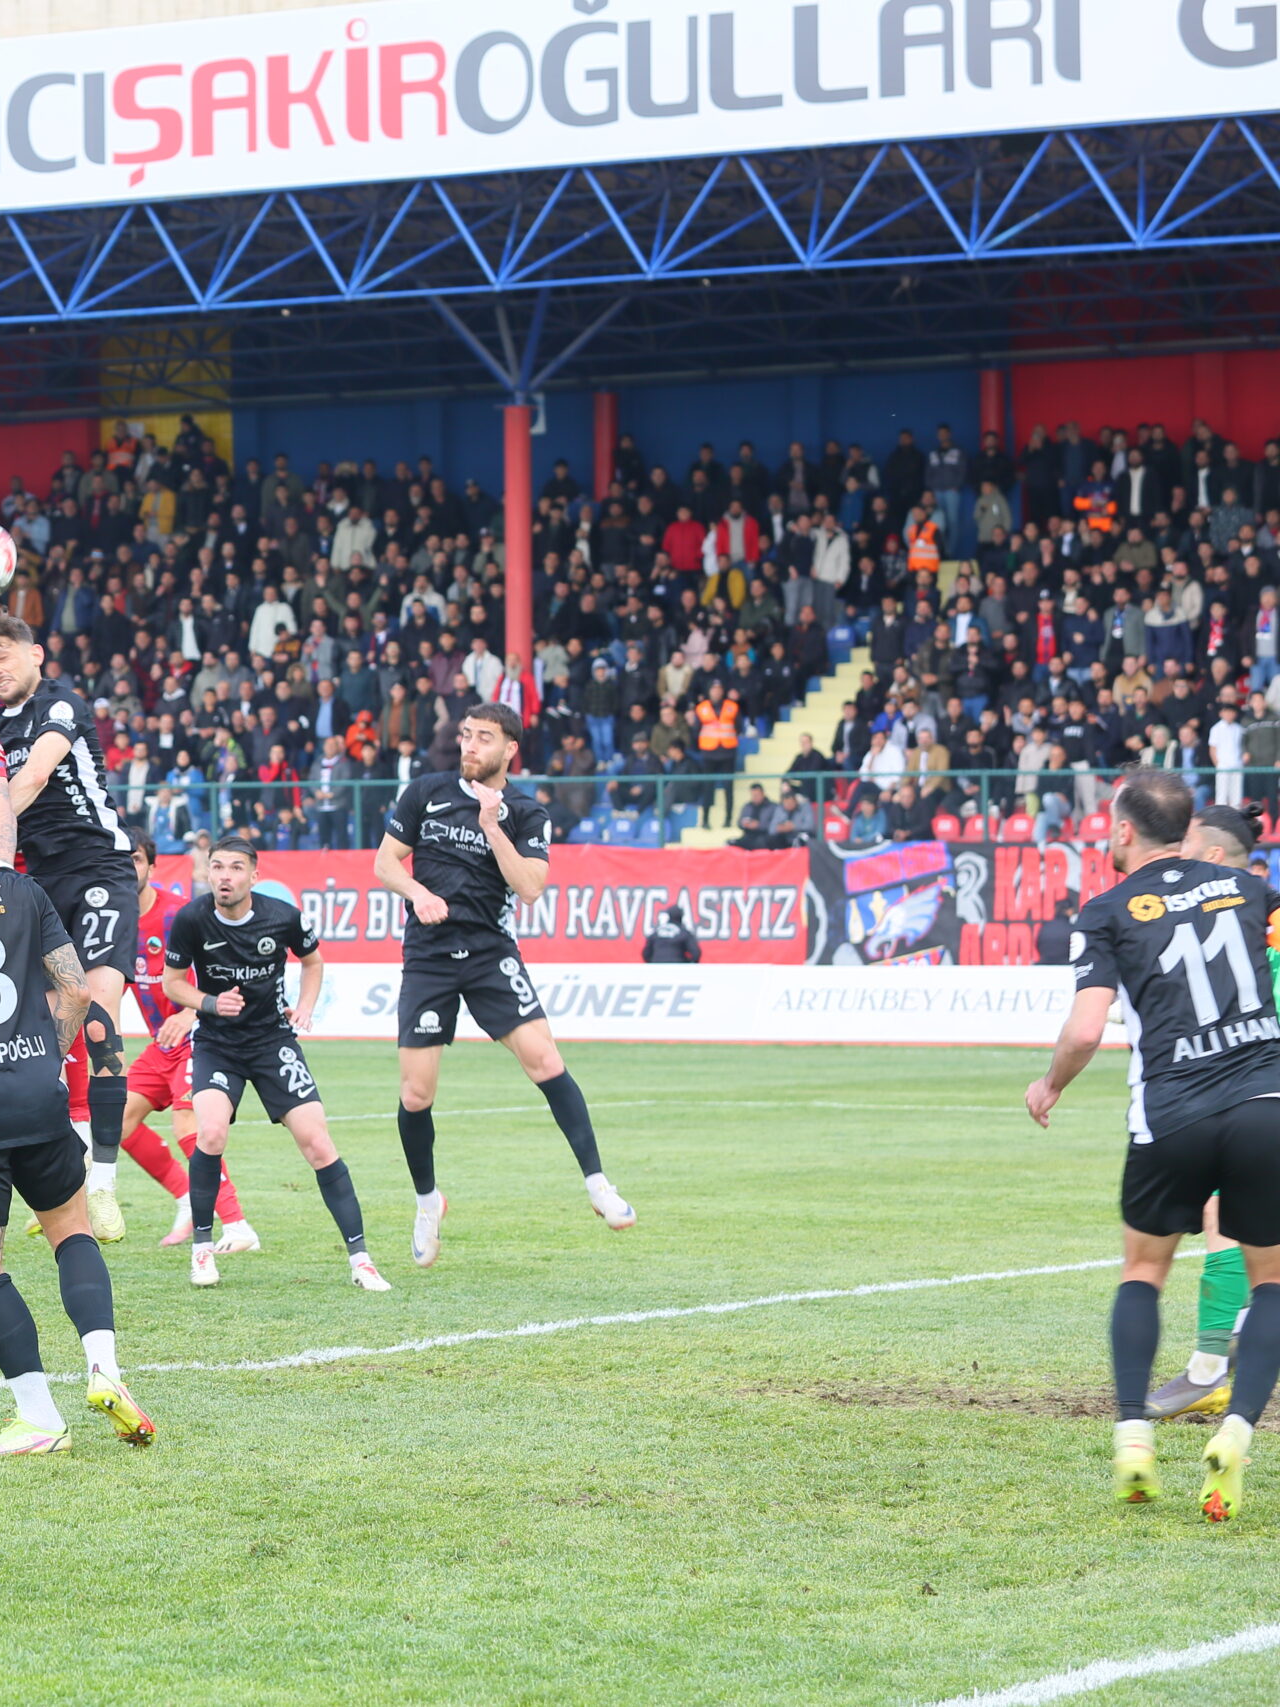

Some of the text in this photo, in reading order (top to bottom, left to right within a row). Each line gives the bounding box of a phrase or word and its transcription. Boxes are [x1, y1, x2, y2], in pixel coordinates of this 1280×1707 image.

[300, 878, 359, 940] BİZ
[565, 886, 801, 938] KAVGASIYIZ
[82, 909, 120, 949] 27
[1158, 908, 1263, 1028] 11
[509, 976, 533, 1004] 9
[772, 987, 1066, 1013] ARTUKBEY KAHVE
[1172, 1025, 1223, 1063] ALİ
[279, 1060, 313, 1093] 28
